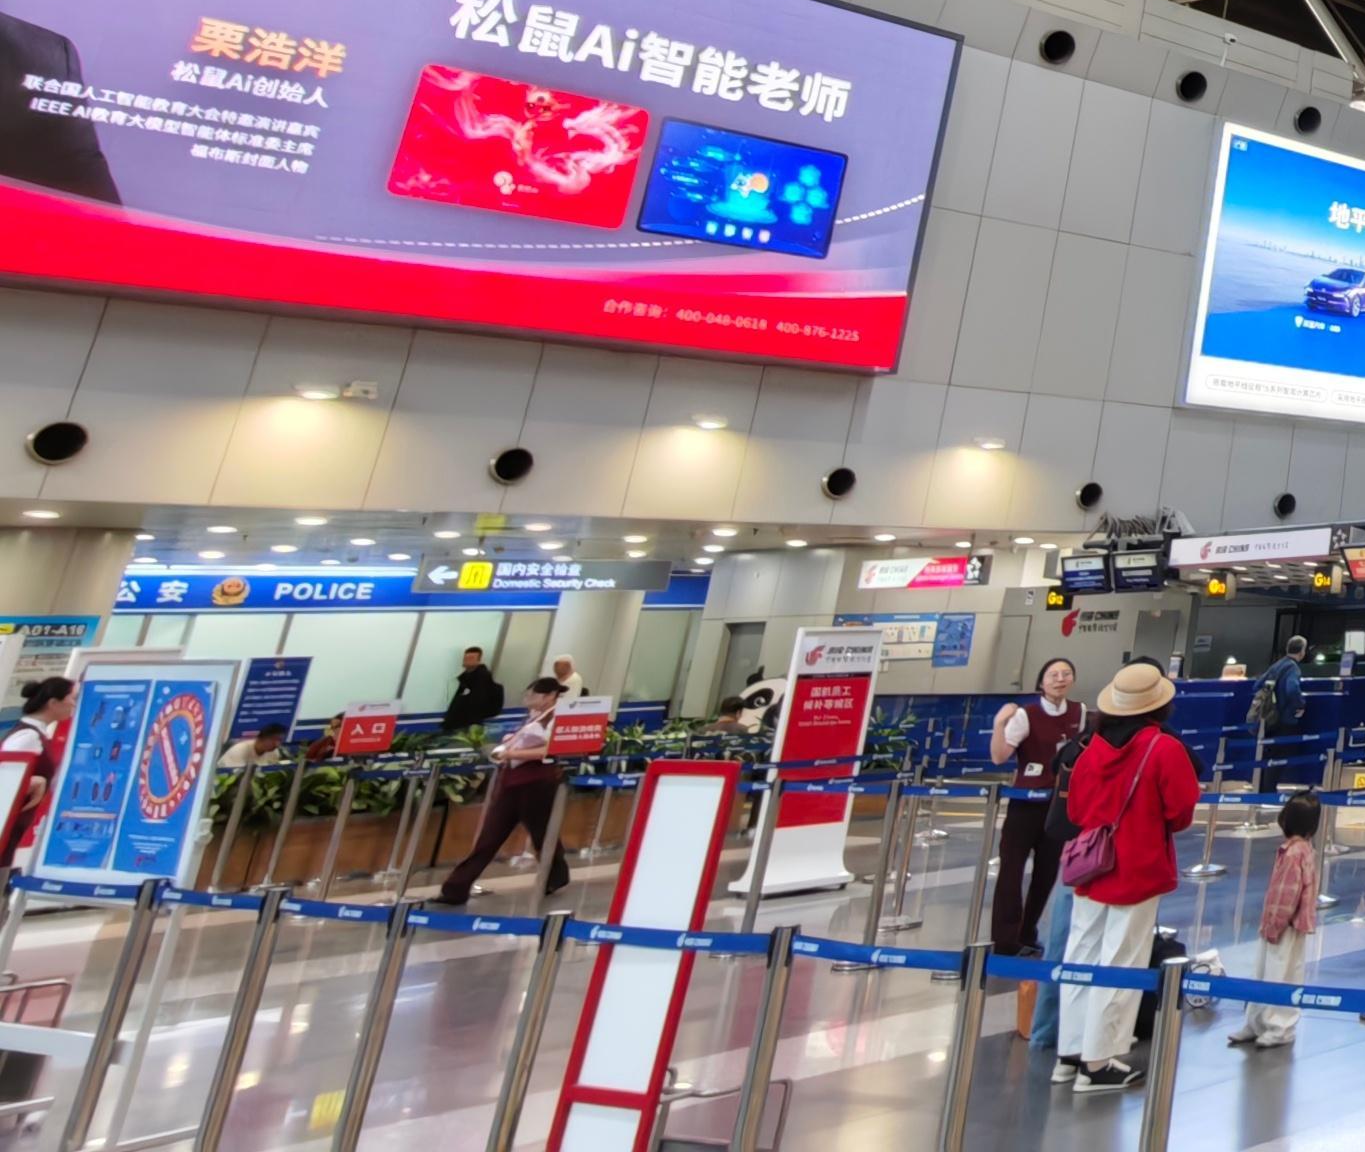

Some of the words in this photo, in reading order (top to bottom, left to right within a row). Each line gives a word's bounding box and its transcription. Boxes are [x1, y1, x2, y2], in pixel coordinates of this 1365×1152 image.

[191, 16, 347, 80] 栗浩洋
[171, 60, 329, 108] 松鼠Ai创始人
[29, 98, 71, 117] IEEE
[496, 562, 582, 577] 国内安全检查
[273, 582, 375, 600] POLICE
[492, 578, 542, 589] Domestic
[543, 578, 583, 590] Security
[584, 578, 616, 589] Check
[351, 723, 387, 735] 入口
